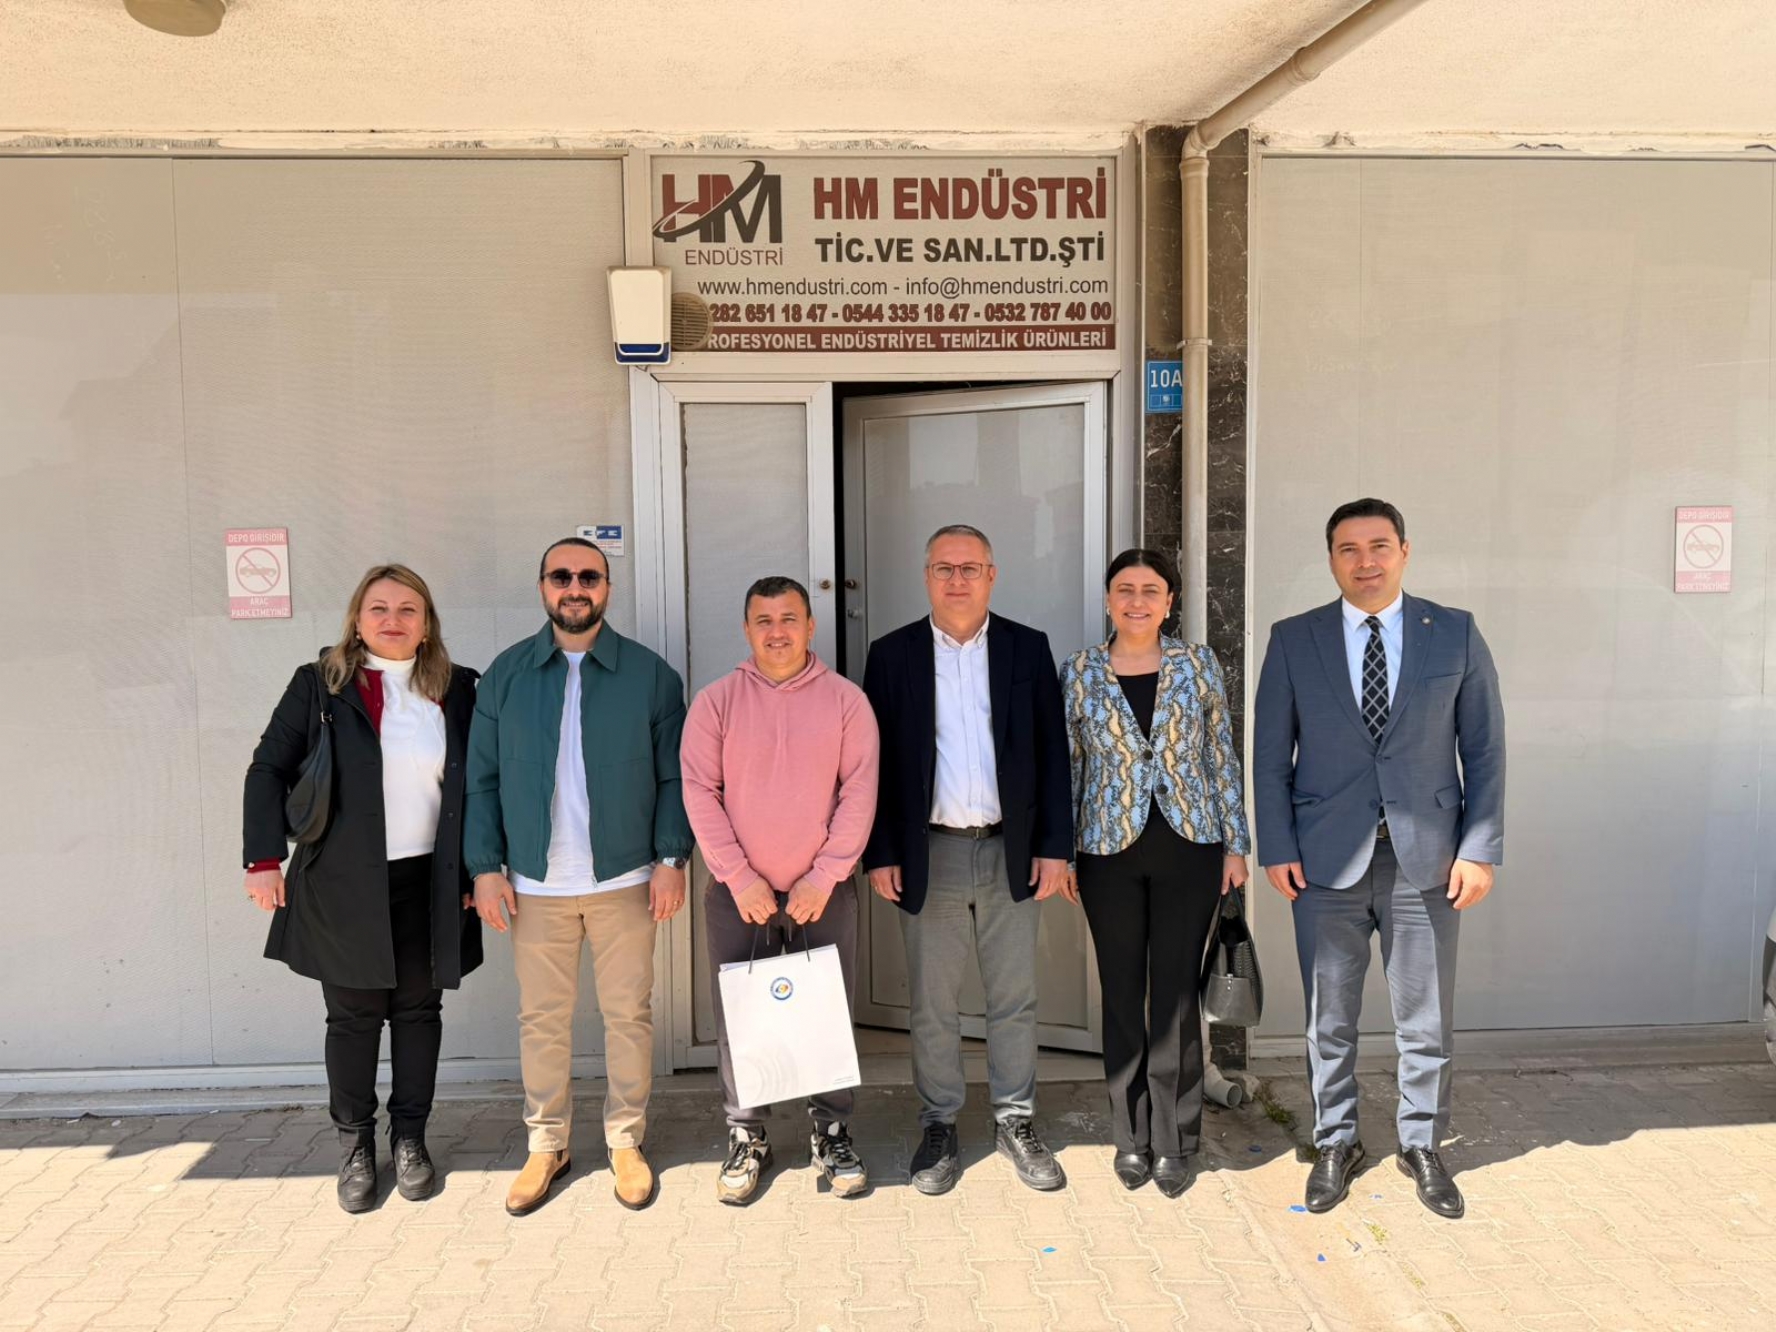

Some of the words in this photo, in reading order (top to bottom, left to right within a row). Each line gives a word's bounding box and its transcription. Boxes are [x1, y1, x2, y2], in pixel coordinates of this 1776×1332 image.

[813, 177, 879, 220] HM
[893, 166, 1107, 220] ENDÜSTRİ
[661, 173, 783, 243] HM
[684, 247, 784, 266] ENDÜSTRİ
[814, 232, 914, 263] TİC.VE
[923, 231, 1104, 268] SAN.LTD.ŞTİ
[697, 277, 888, 296] www.hmendustri.com
[905, 276, 1109, 300] info@hmendustri.com
[709, 303, 741, 323] 282
[745, 303, 775, 323] 651
[781, 303, 802, 323] 18
[806, 303, 828, 323] 47
[842, 303, 884, 323] 0544
[888, 303, 919, 323] 335
[924, 303, 945, 323] 18
[949, 303, 970, 323] 47
[984, 302, 1026, 323] 0532
[1030, 302, 1061, 322] 787
[1065, 302, 1087, 321] 40
[1091, 302, 1112, 321] 00
[707, 333, 816, 349] ROFESYONEL
[821, 330, 936, 349] ENDÜSTRİYEL
[941, 329, 1019, 348] TEMİZLİK
[1023, 328, 1107, 348] ÜRÜNLERİ
[1150, 369, 1182, 388] 10A
[228, 533, 248, 543] DEPO
